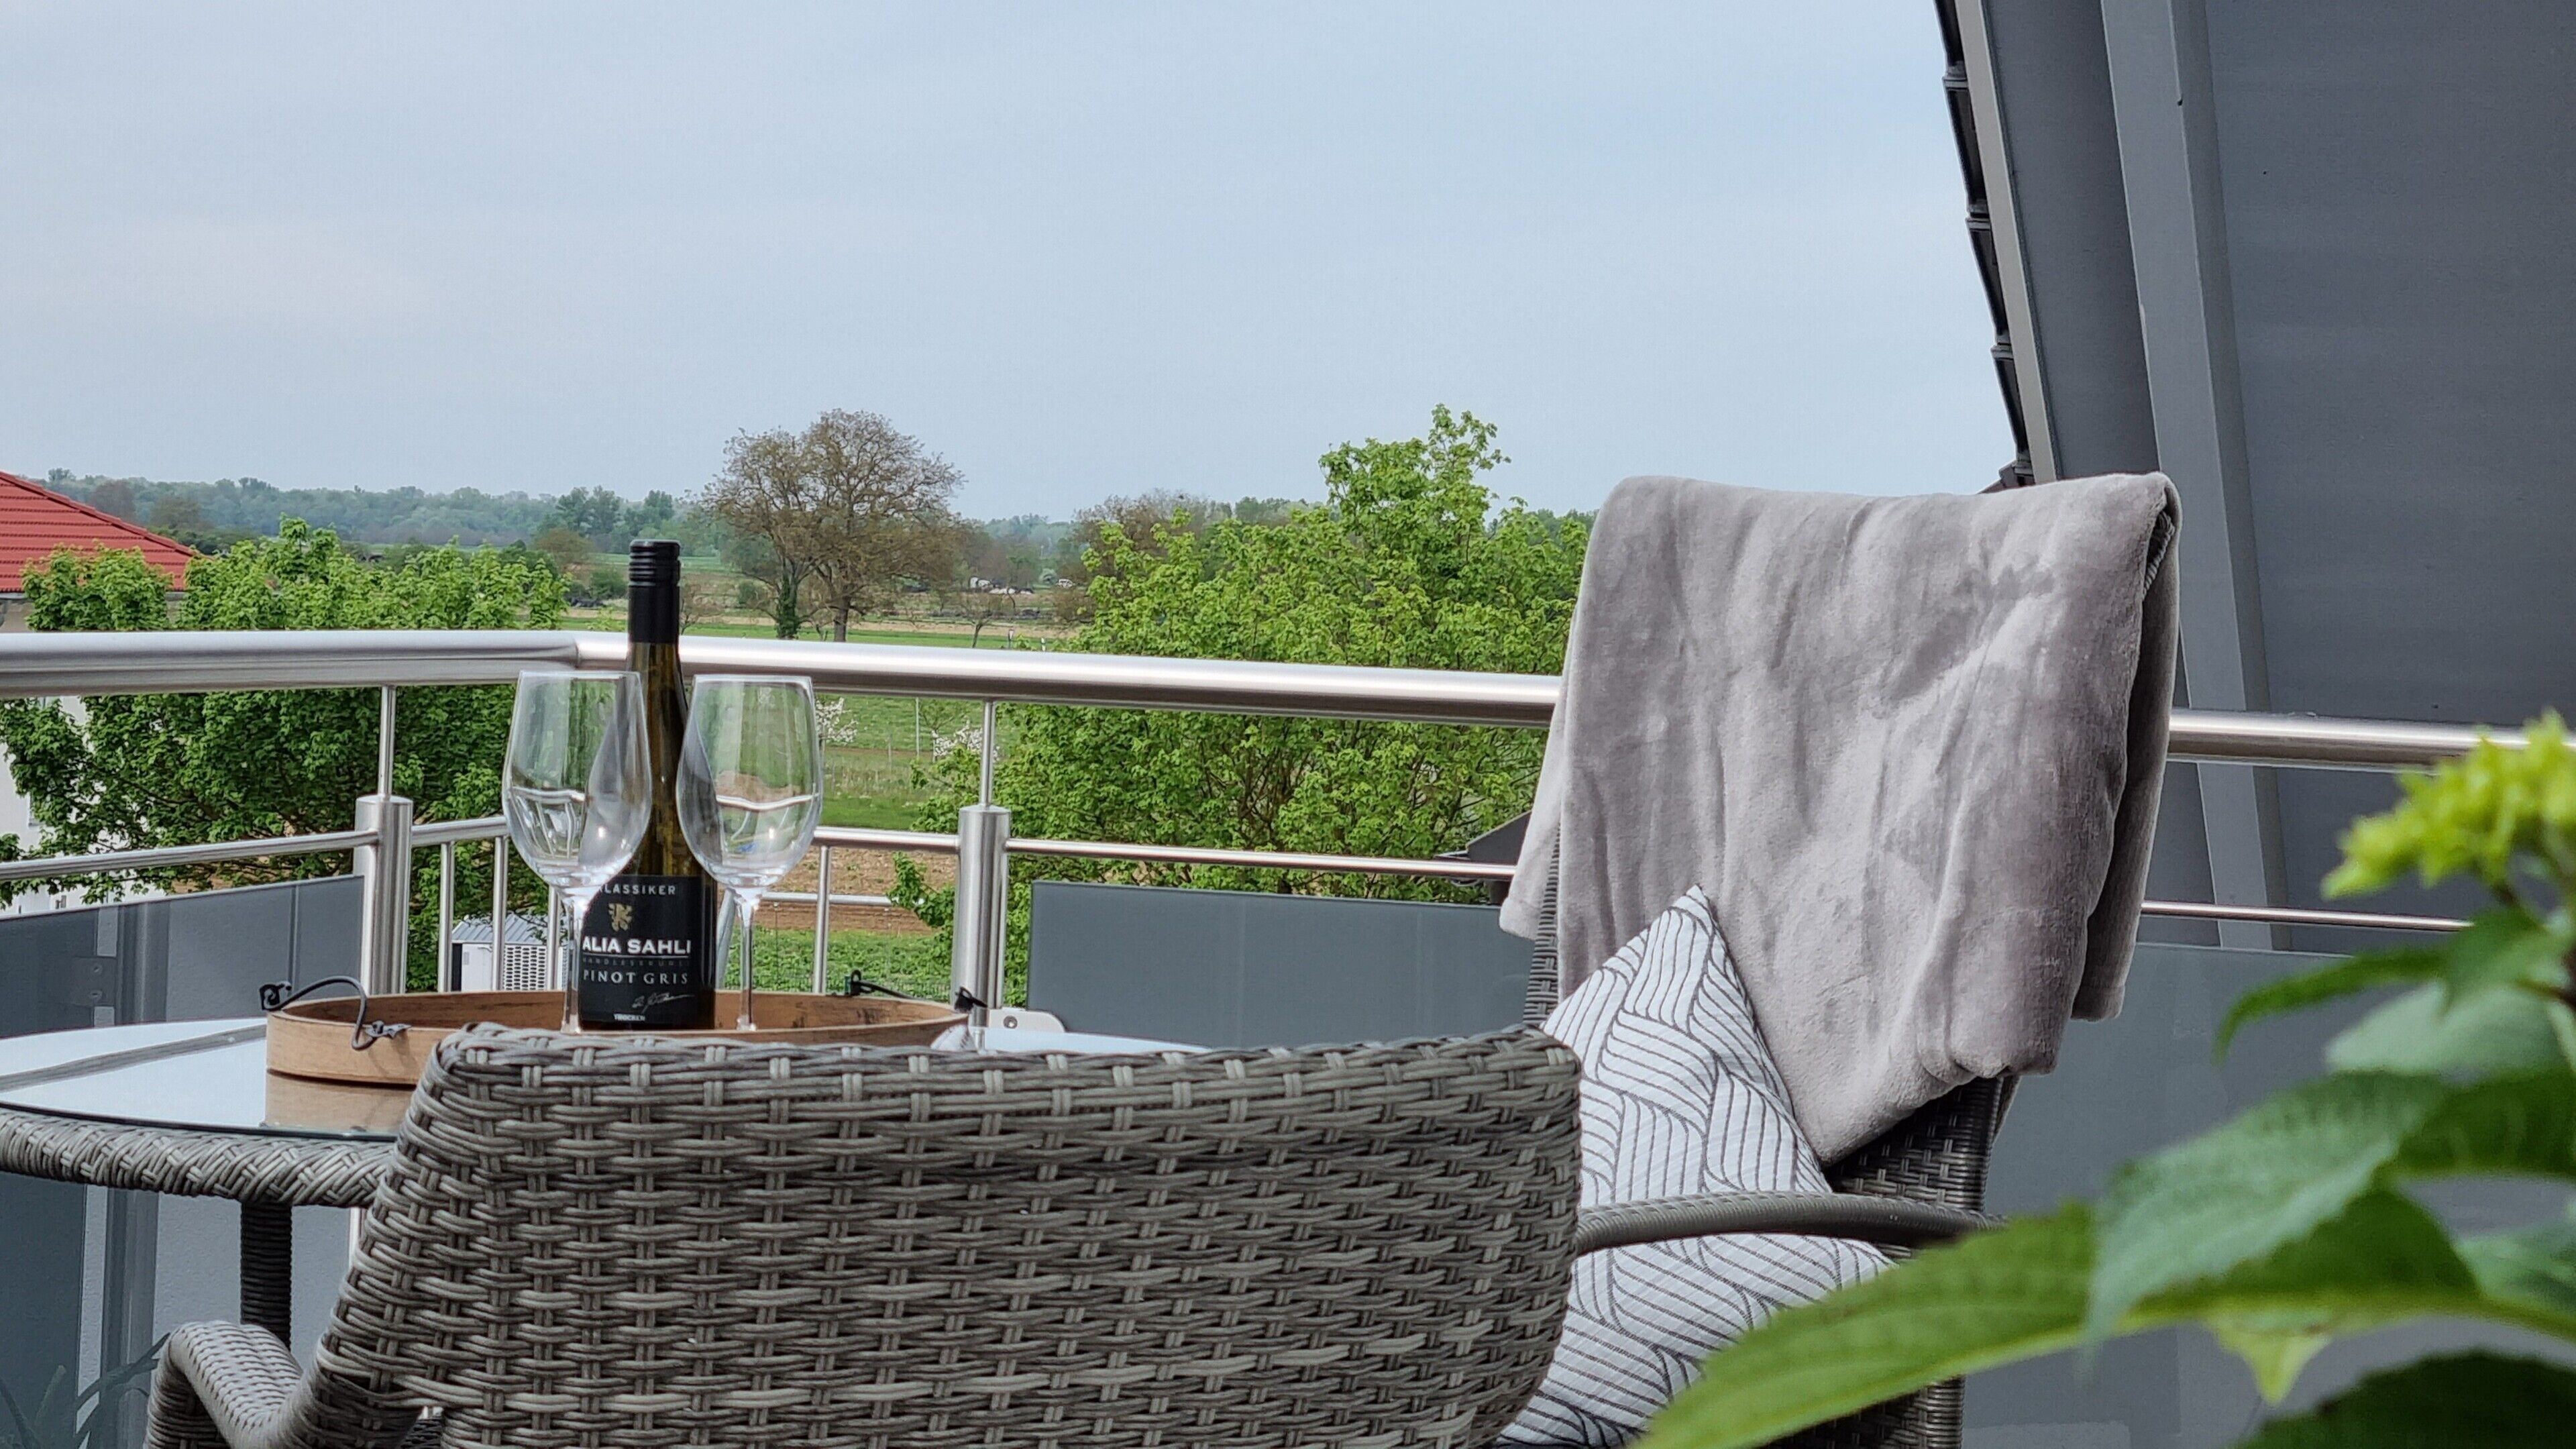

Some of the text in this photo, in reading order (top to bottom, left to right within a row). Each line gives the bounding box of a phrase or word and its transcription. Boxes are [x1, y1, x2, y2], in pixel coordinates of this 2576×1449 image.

[582, 936, 621, 953] ALIA
[583, 969, 688, 985] PINOT GRIS
